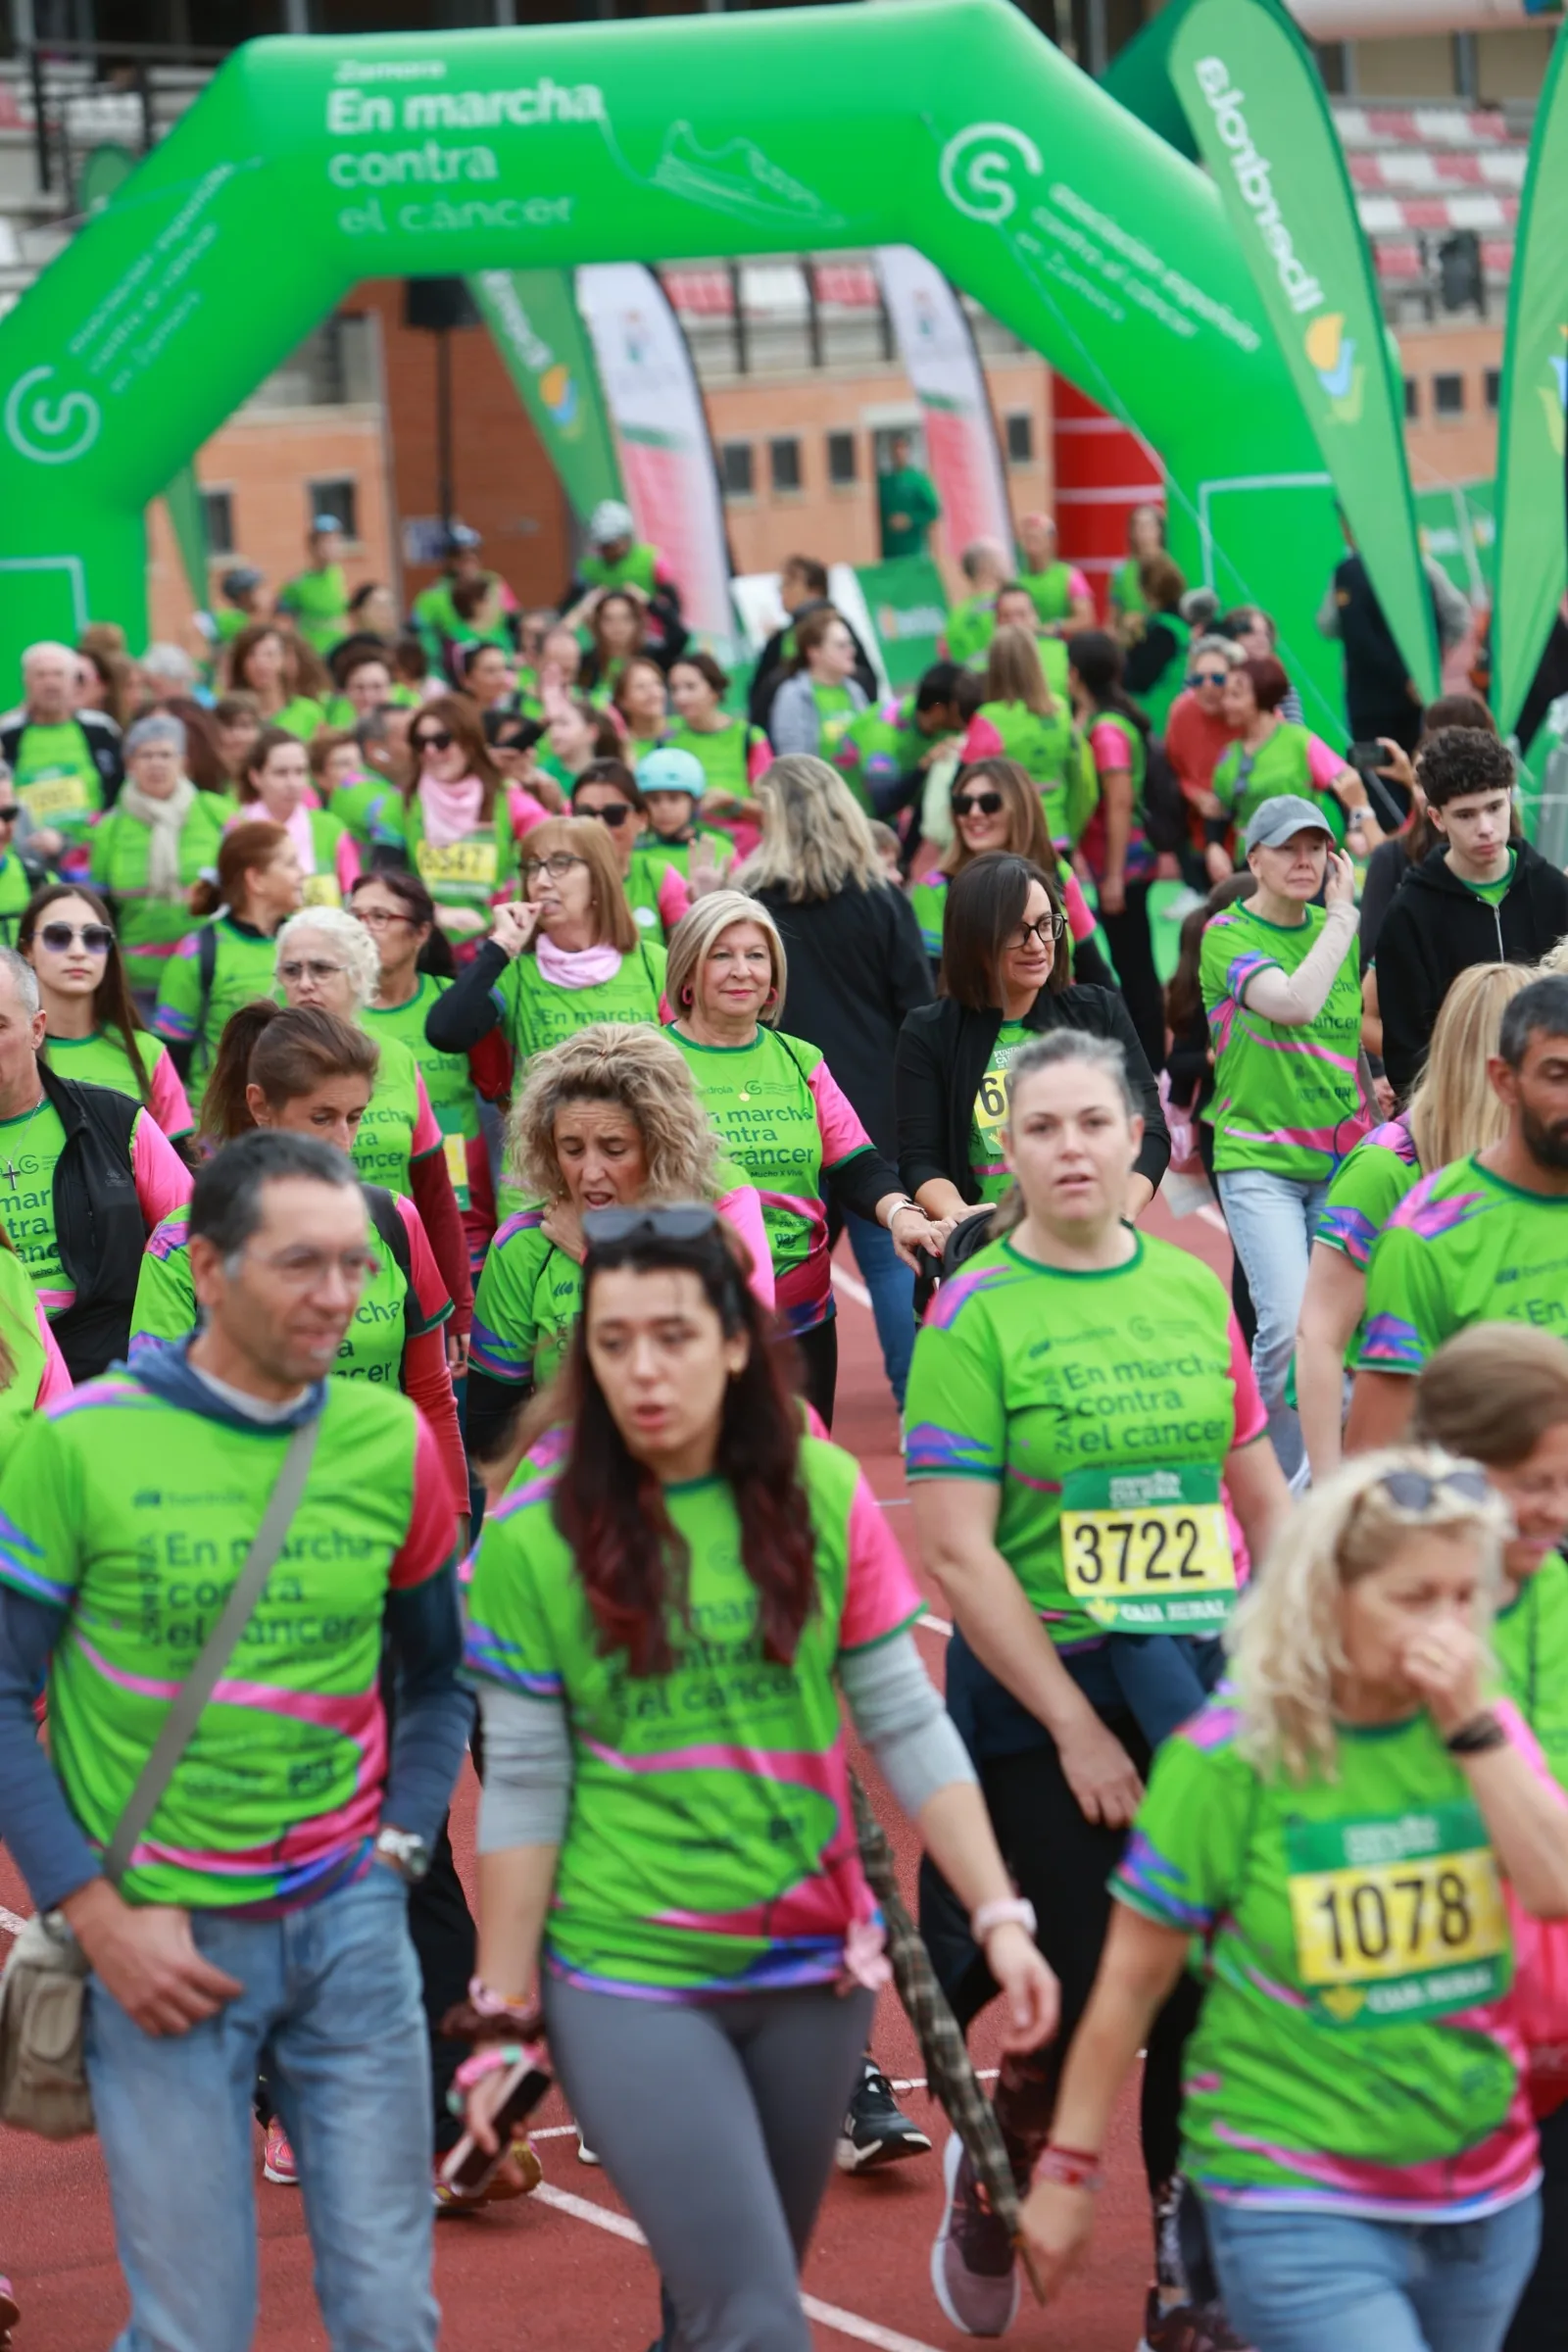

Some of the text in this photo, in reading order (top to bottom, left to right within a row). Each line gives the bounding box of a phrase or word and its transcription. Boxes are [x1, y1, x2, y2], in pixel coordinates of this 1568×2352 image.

[327, 75, 605, 134] En marcha
[328, 139, 499, 187] contra
[338, 196, 388, 233] el
[980, 1075, 1012, 1117] 6
[713, 1127, 778, 1143] ntra
[0, 1189, 51, 1214] mar
[7, 1216, 49, 1239] tra
[1063, 1364, 1106, 1391] En
[1076, 1389, 1184, 1417] contra
[1079, 1423, 1113, 1452] el
[166, 1532, 218, 1567] En
[1074, 1518, 1205, 1585] 3722
[168, 1616, 203, 1649] el
[1318, 1871, 1471, 1964] 1078
